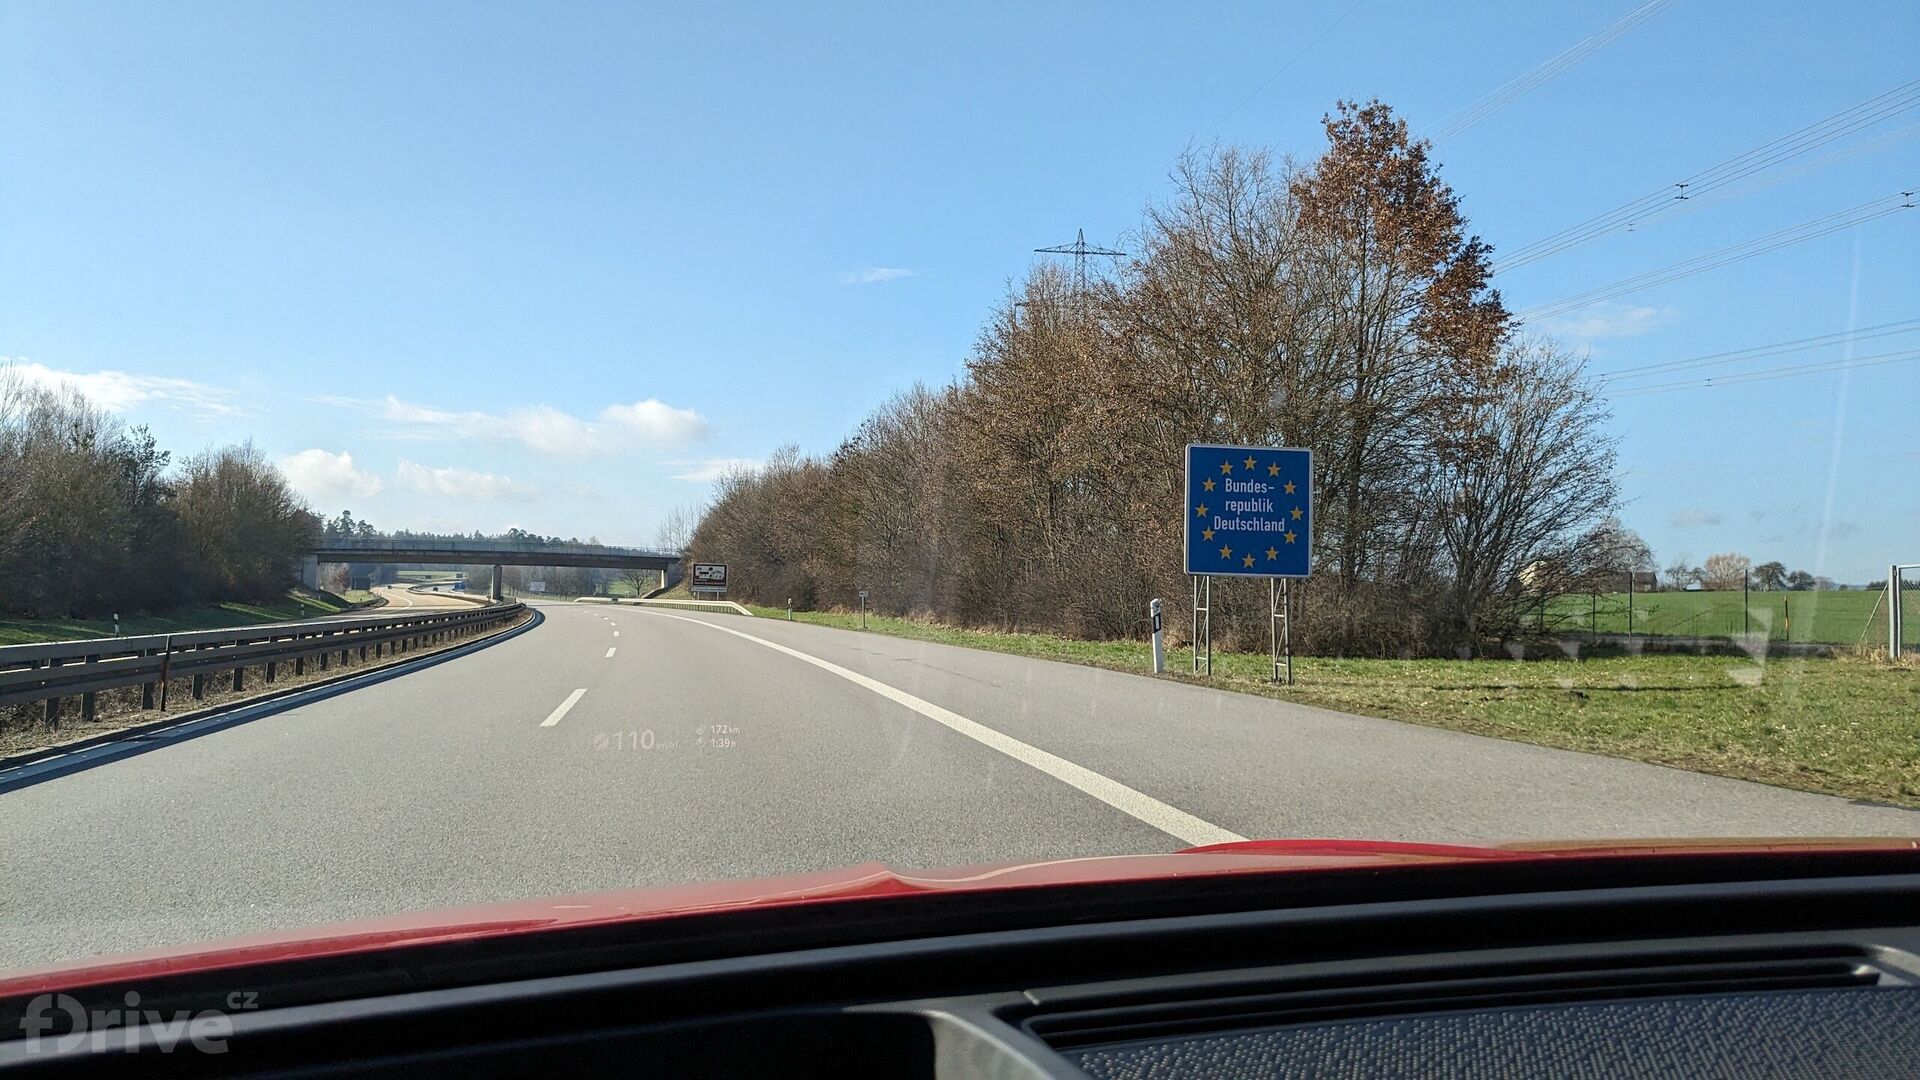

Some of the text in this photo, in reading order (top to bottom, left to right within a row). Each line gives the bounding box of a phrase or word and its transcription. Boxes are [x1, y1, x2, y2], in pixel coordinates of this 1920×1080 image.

[1225, 478, 1275, 494] Bundes-
[1225, 498, 1274, 515] republik
[1214, 516, 1285, 532] Deutschland
[612, 729, 655, 750] 110
